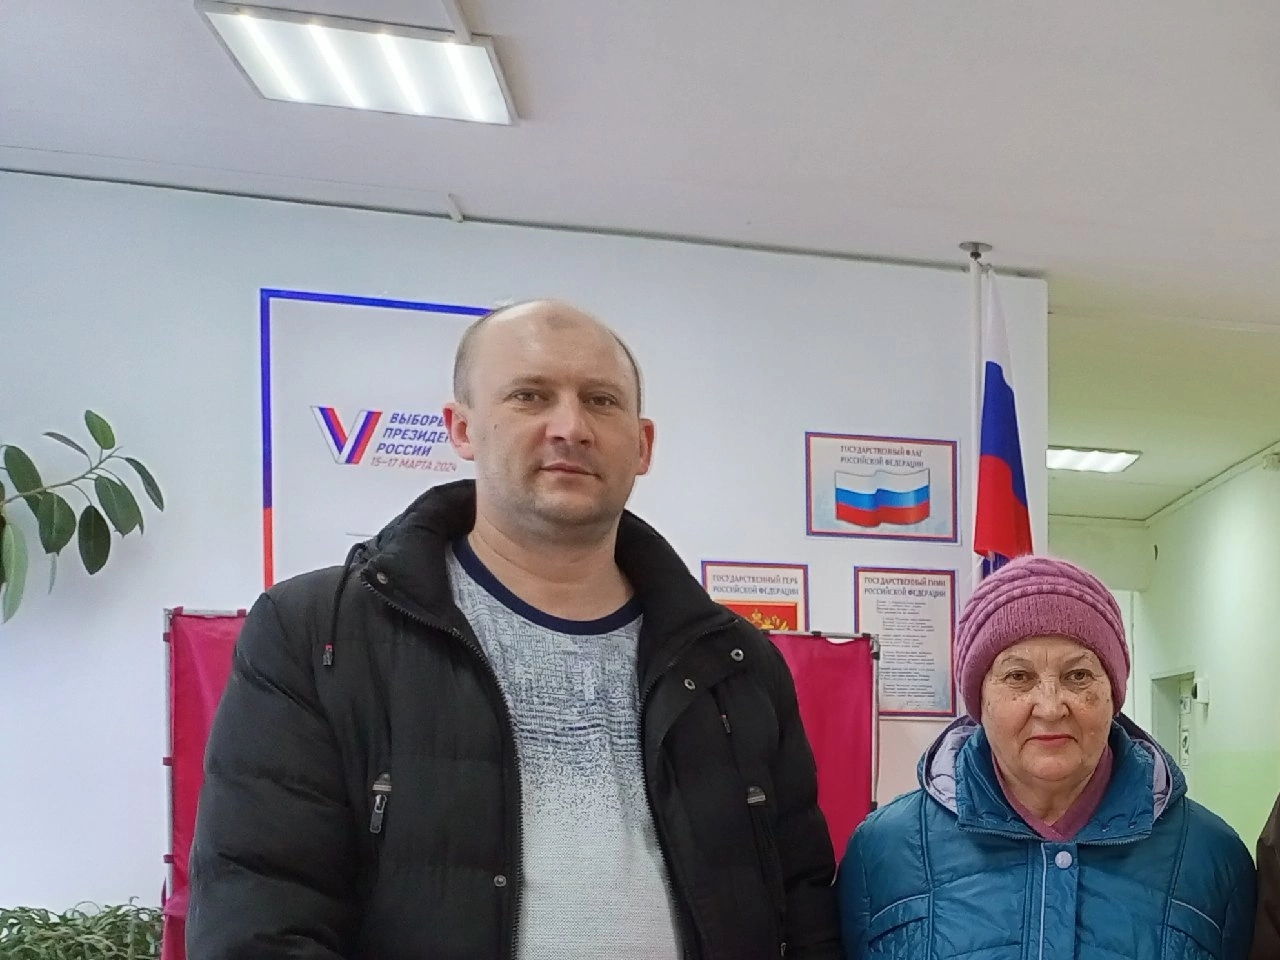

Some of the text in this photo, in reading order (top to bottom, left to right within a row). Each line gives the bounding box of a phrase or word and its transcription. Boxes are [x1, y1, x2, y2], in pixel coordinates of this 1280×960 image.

[376, 442, 433, 457] РОССИИ
[399, 458, 433, 470] МАРТА
[433, 461, 458, 472] 2024
